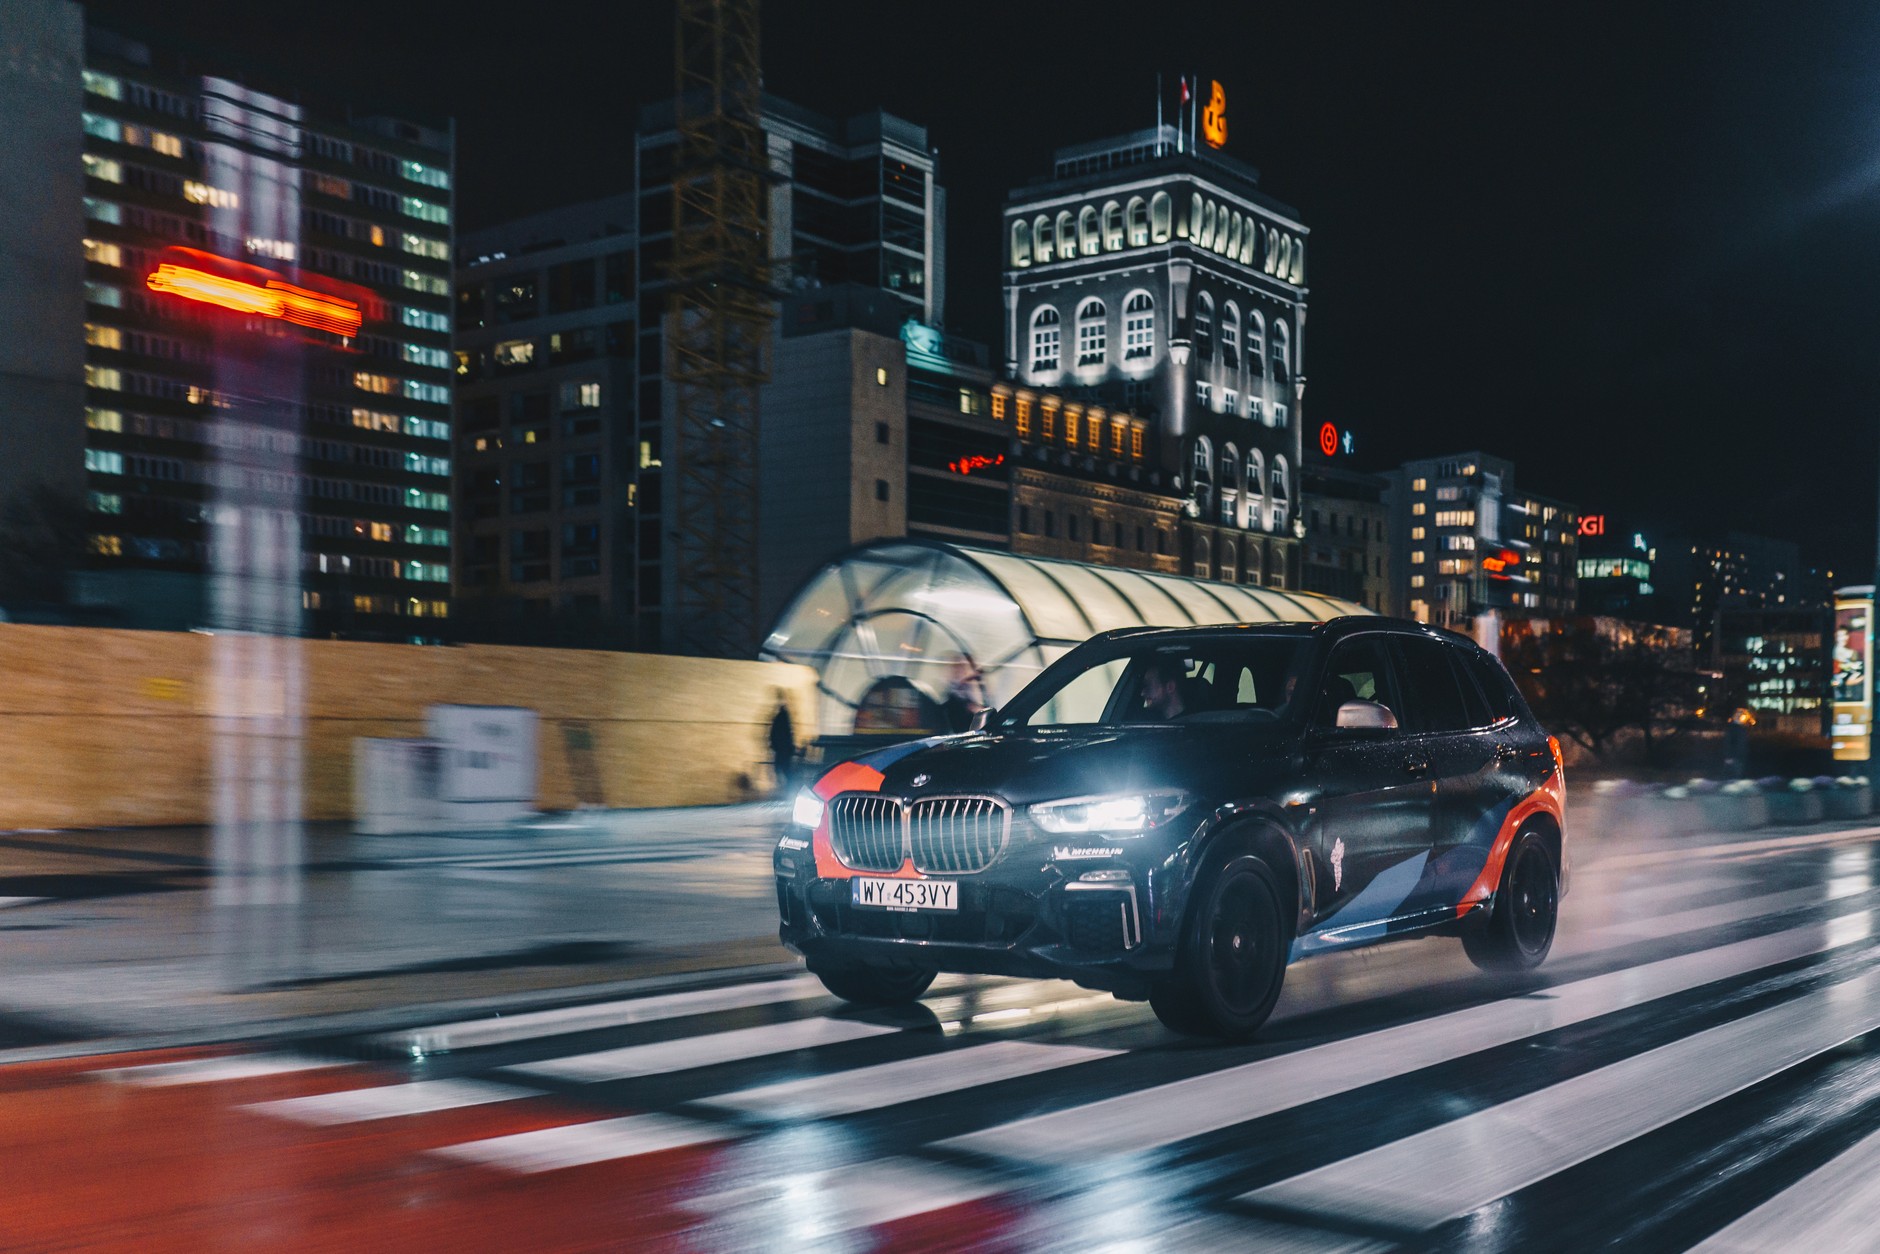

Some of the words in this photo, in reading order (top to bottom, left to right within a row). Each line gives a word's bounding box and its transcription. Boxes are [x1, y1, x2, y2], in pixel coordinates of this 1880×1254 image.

[1071, 847, 1123, 856] MICHELIN
[863, 881, 885, 904] WY
[893, 883, 952, 907] 453VY
